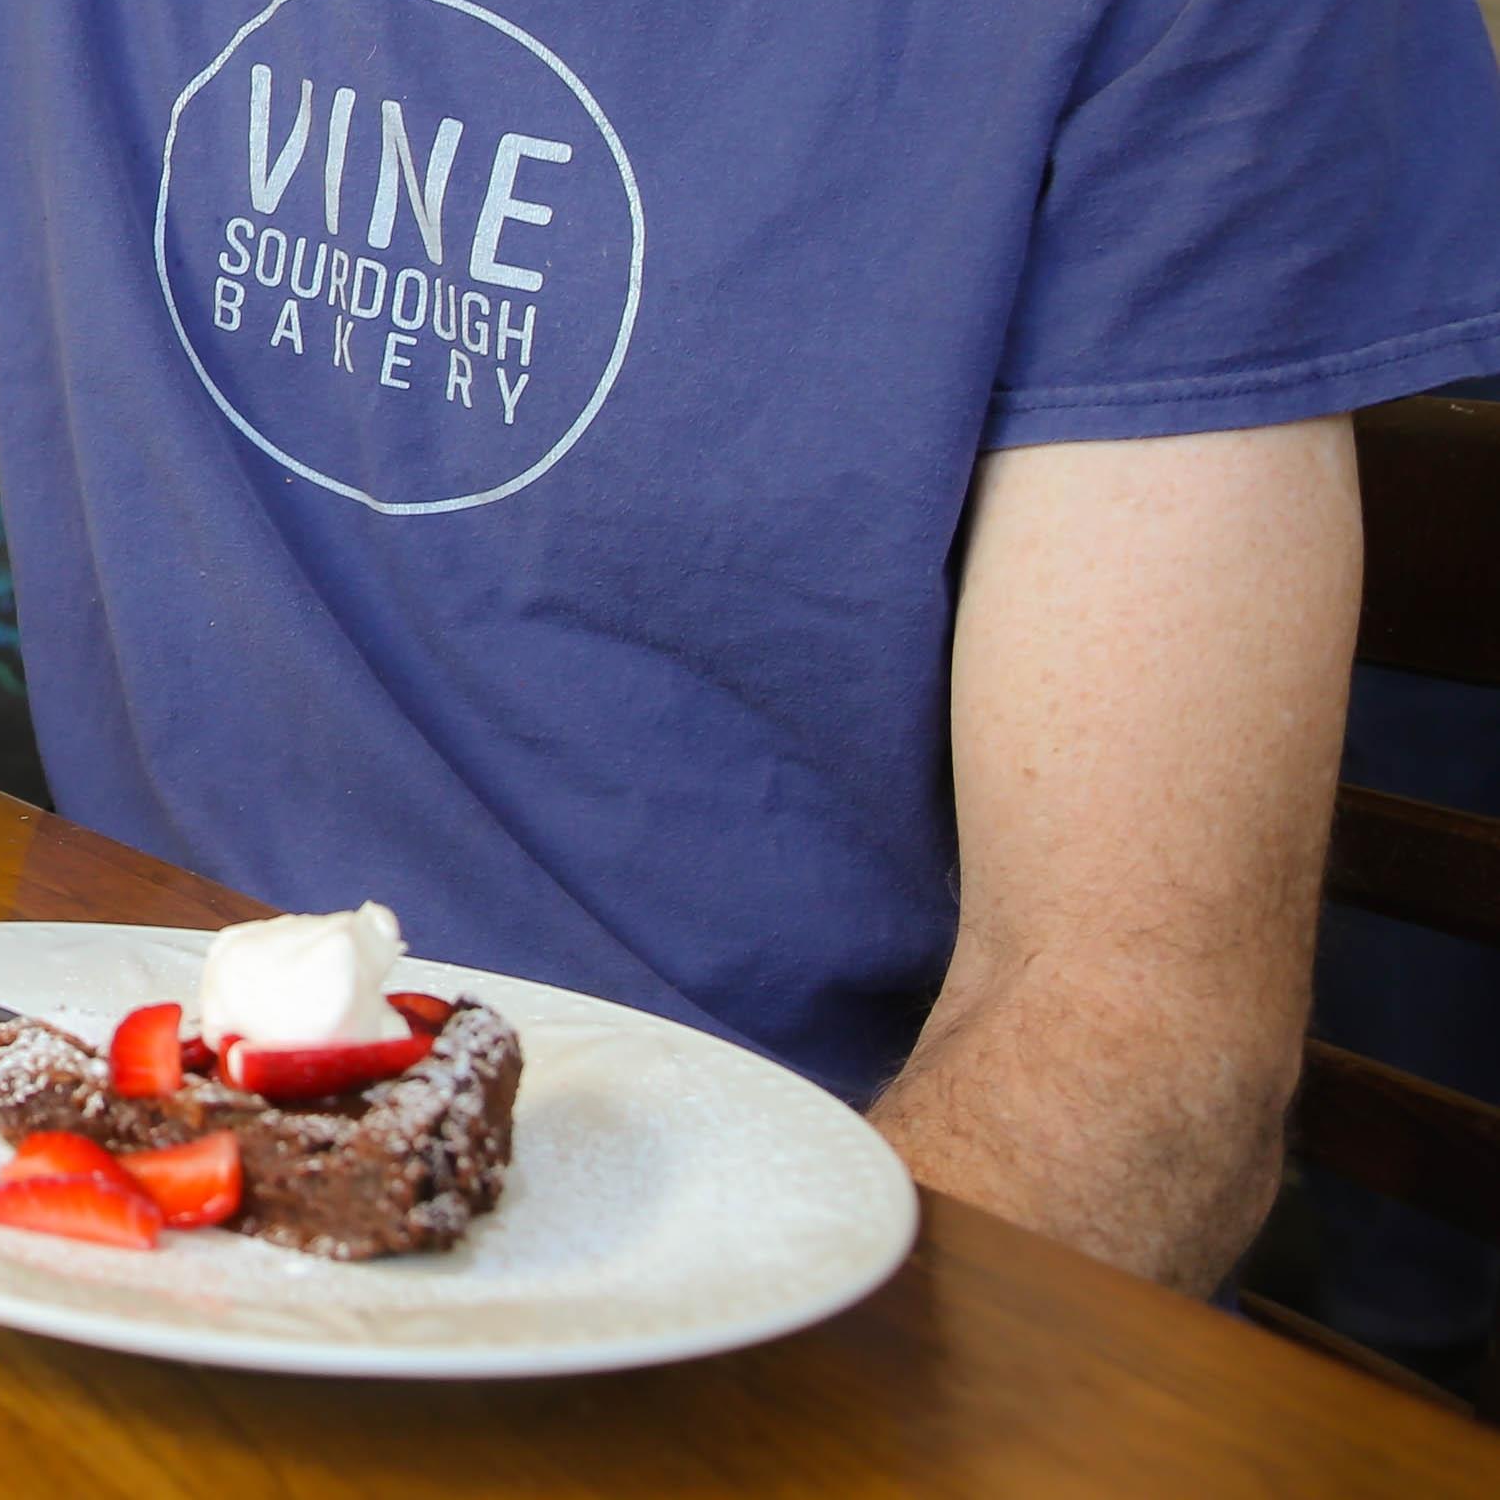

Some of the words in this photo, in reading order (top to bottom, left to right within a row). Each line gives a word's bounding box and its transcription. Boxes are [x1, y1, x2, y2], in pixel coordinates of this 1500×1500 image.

[249, 64, 572, 292] VINE
[213, 277, 530, 425] BAKERY
[218, 217, 537, 366] SOURDOUGH
